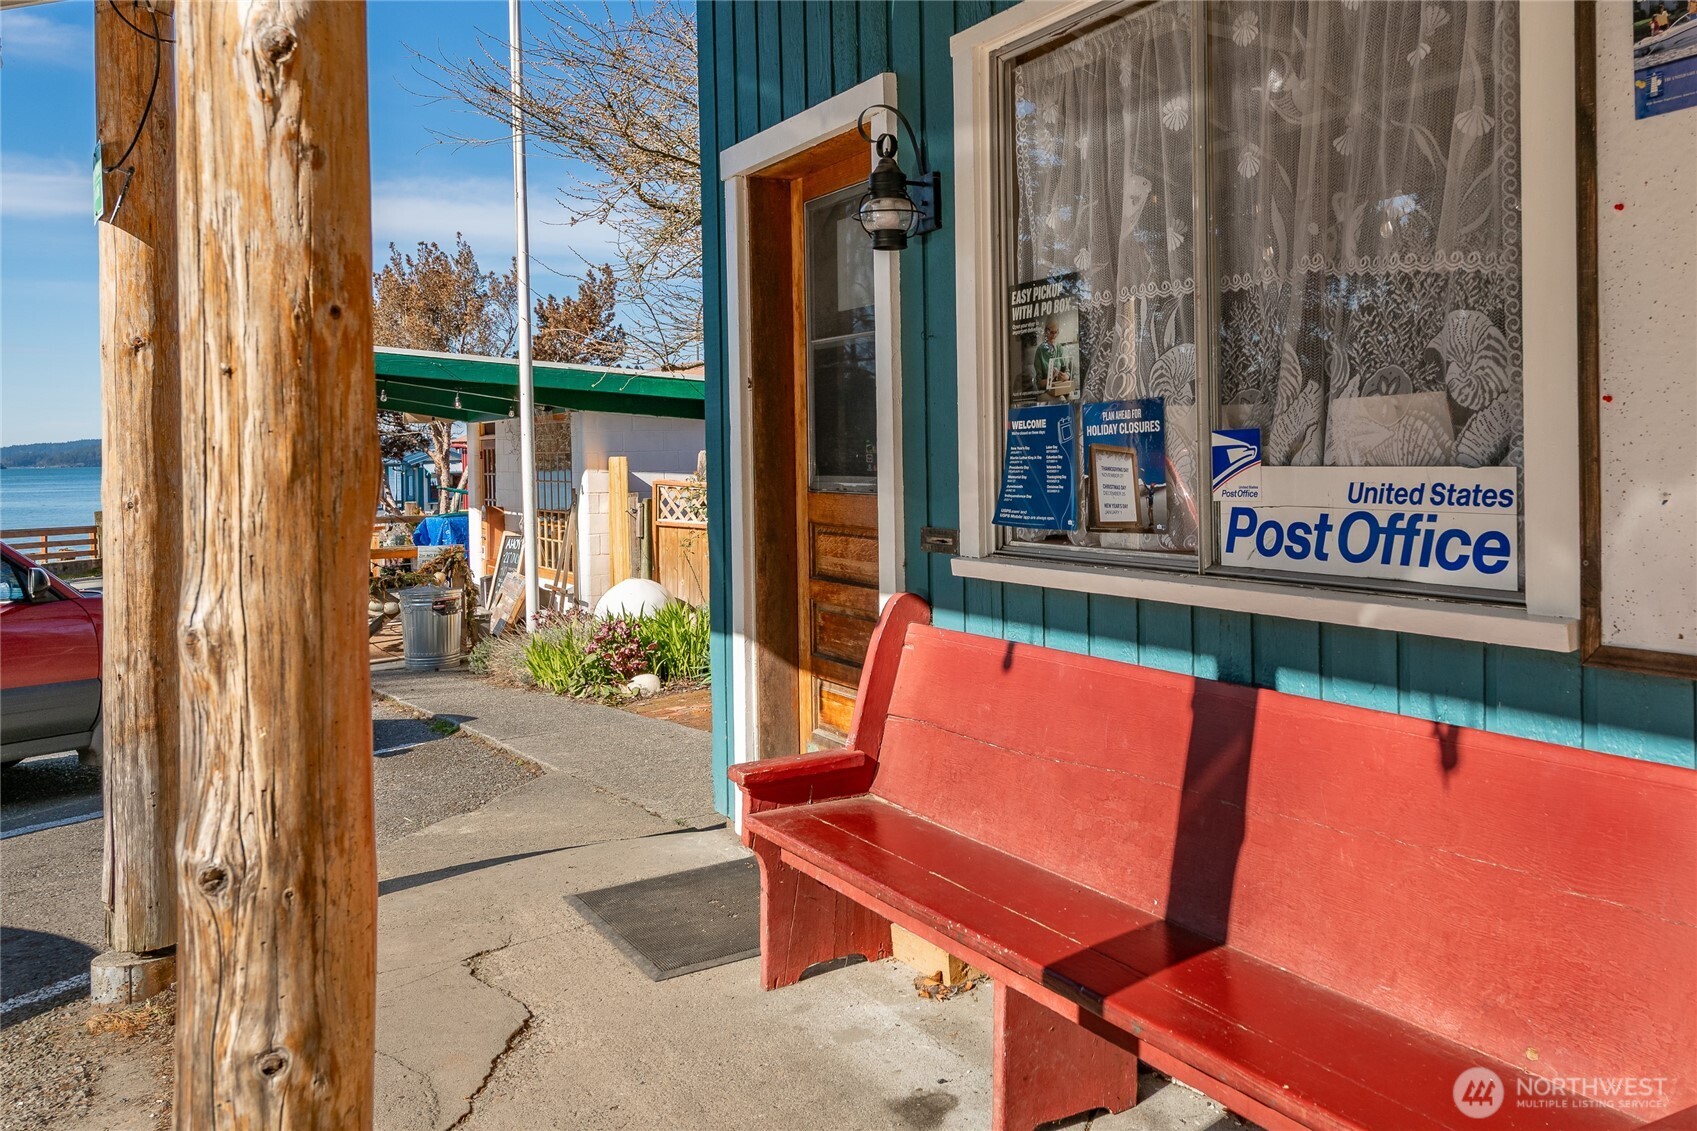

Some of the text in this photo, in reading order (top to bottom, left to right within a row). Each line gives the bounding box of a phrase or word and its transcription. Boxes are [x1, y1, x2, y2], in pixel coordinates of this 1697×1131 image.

[1012, 283, 1062, 305] EASY PICKUP
[1012, 297, 1071, 321] WITH A PO BOX
[1012, 419, 1046, 430] WELCOME
[1103, 409, 1142, 421] PLAN AHEAD FOR
[1087, 420, 1160, 436] HOLIDAY CLOSURES
[1222, 490, 1258, 498] Post Office
[1348, 482, 1514, 508] United States
[1225, 506, 1511, 575] Post Office
